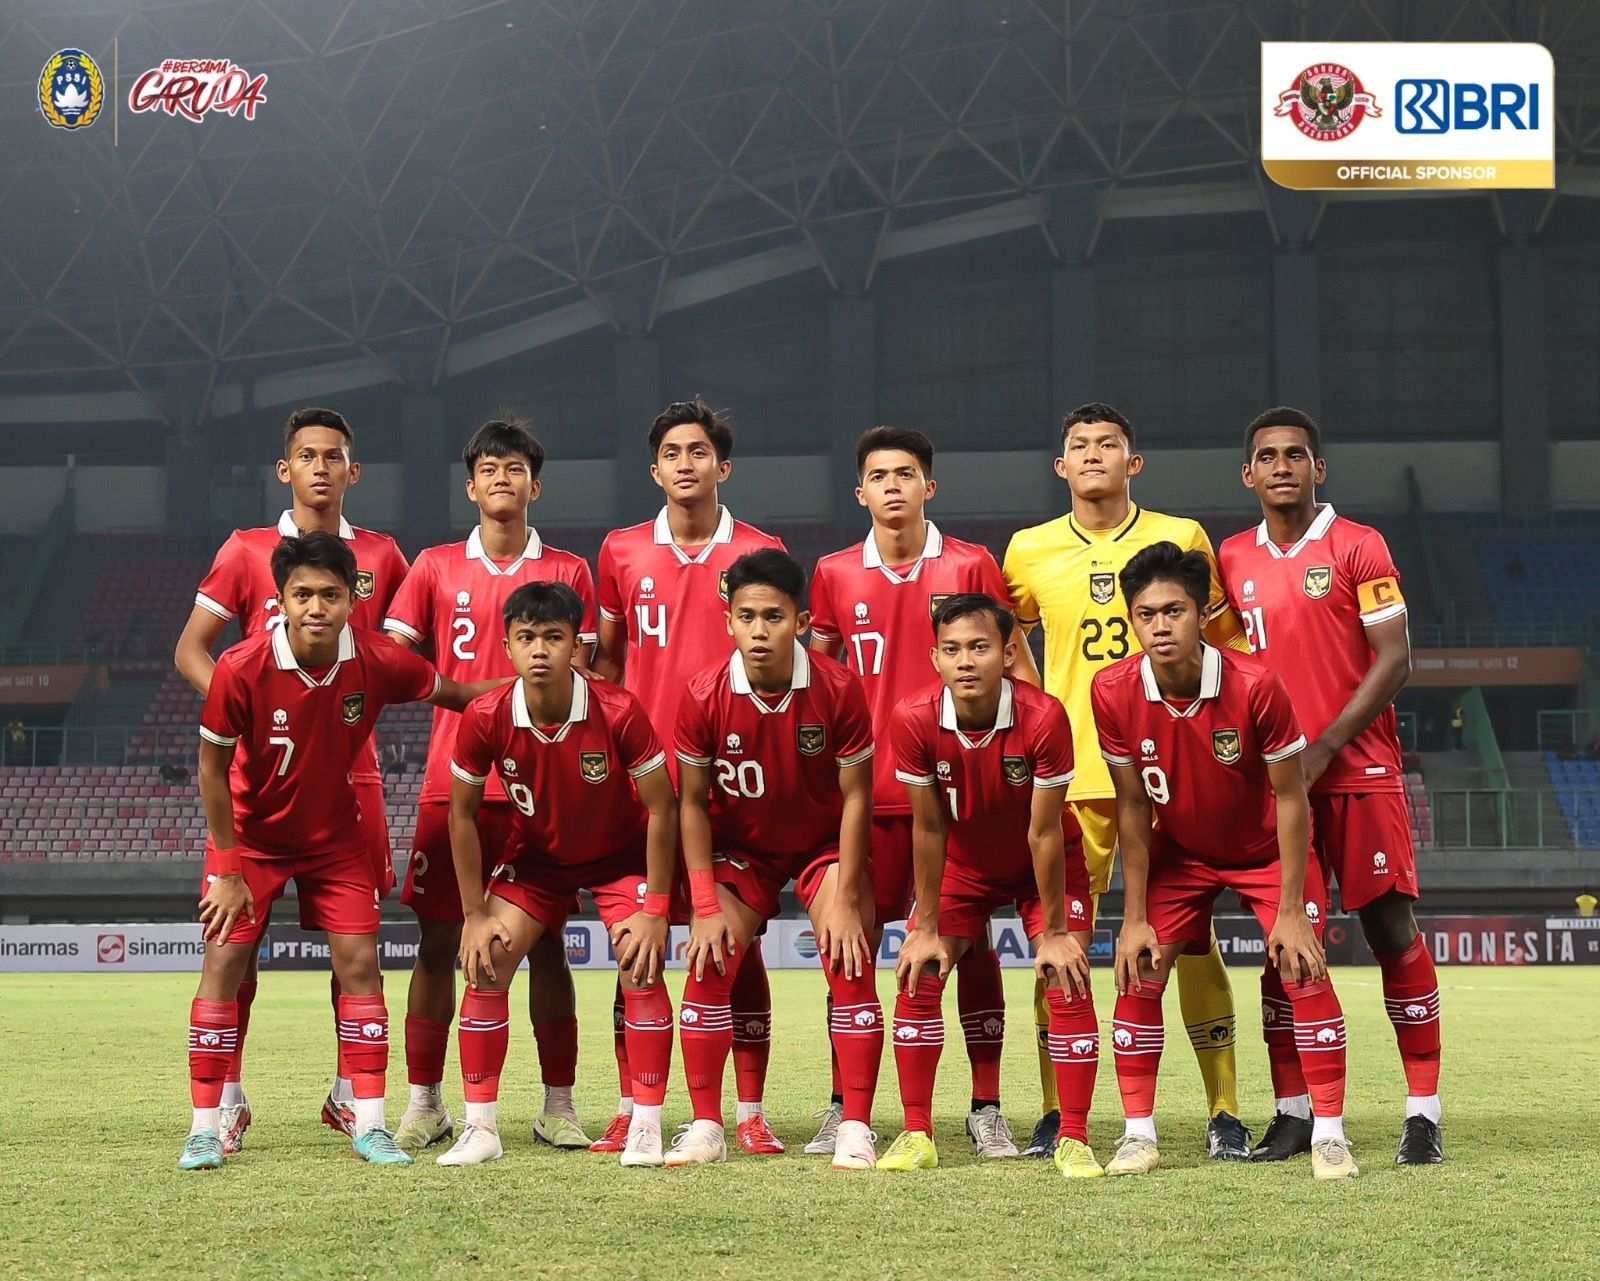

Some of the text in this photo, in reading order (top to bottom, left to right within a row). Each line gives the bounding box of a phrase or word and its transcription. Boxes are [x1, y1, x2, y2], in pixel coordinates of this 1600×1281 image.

[1372, 581, 1395, 605] C
[452, 617, 477, 660] 2
[634, 604, 668, 648] 14
[1081, 616, 1129, 661] 23
[850, 631, 885, 676] 17
[1506, 656, 1519, 669] 12
[38, 674, 50, 687] 10
[269, 736, 295, 776] 7
[714, 759, 765, 798] 20
[1141, 766, 1170, 805] 9
[946, 787, 959, 822] 1
[412, 850, 429, 894] 2
[0, 938, 79, 956] inarmas
[128, 937, 207, 956] sinarma
[273, 941, 299, 958] PT
[1422, 931, 1574, 962] DONESIA
